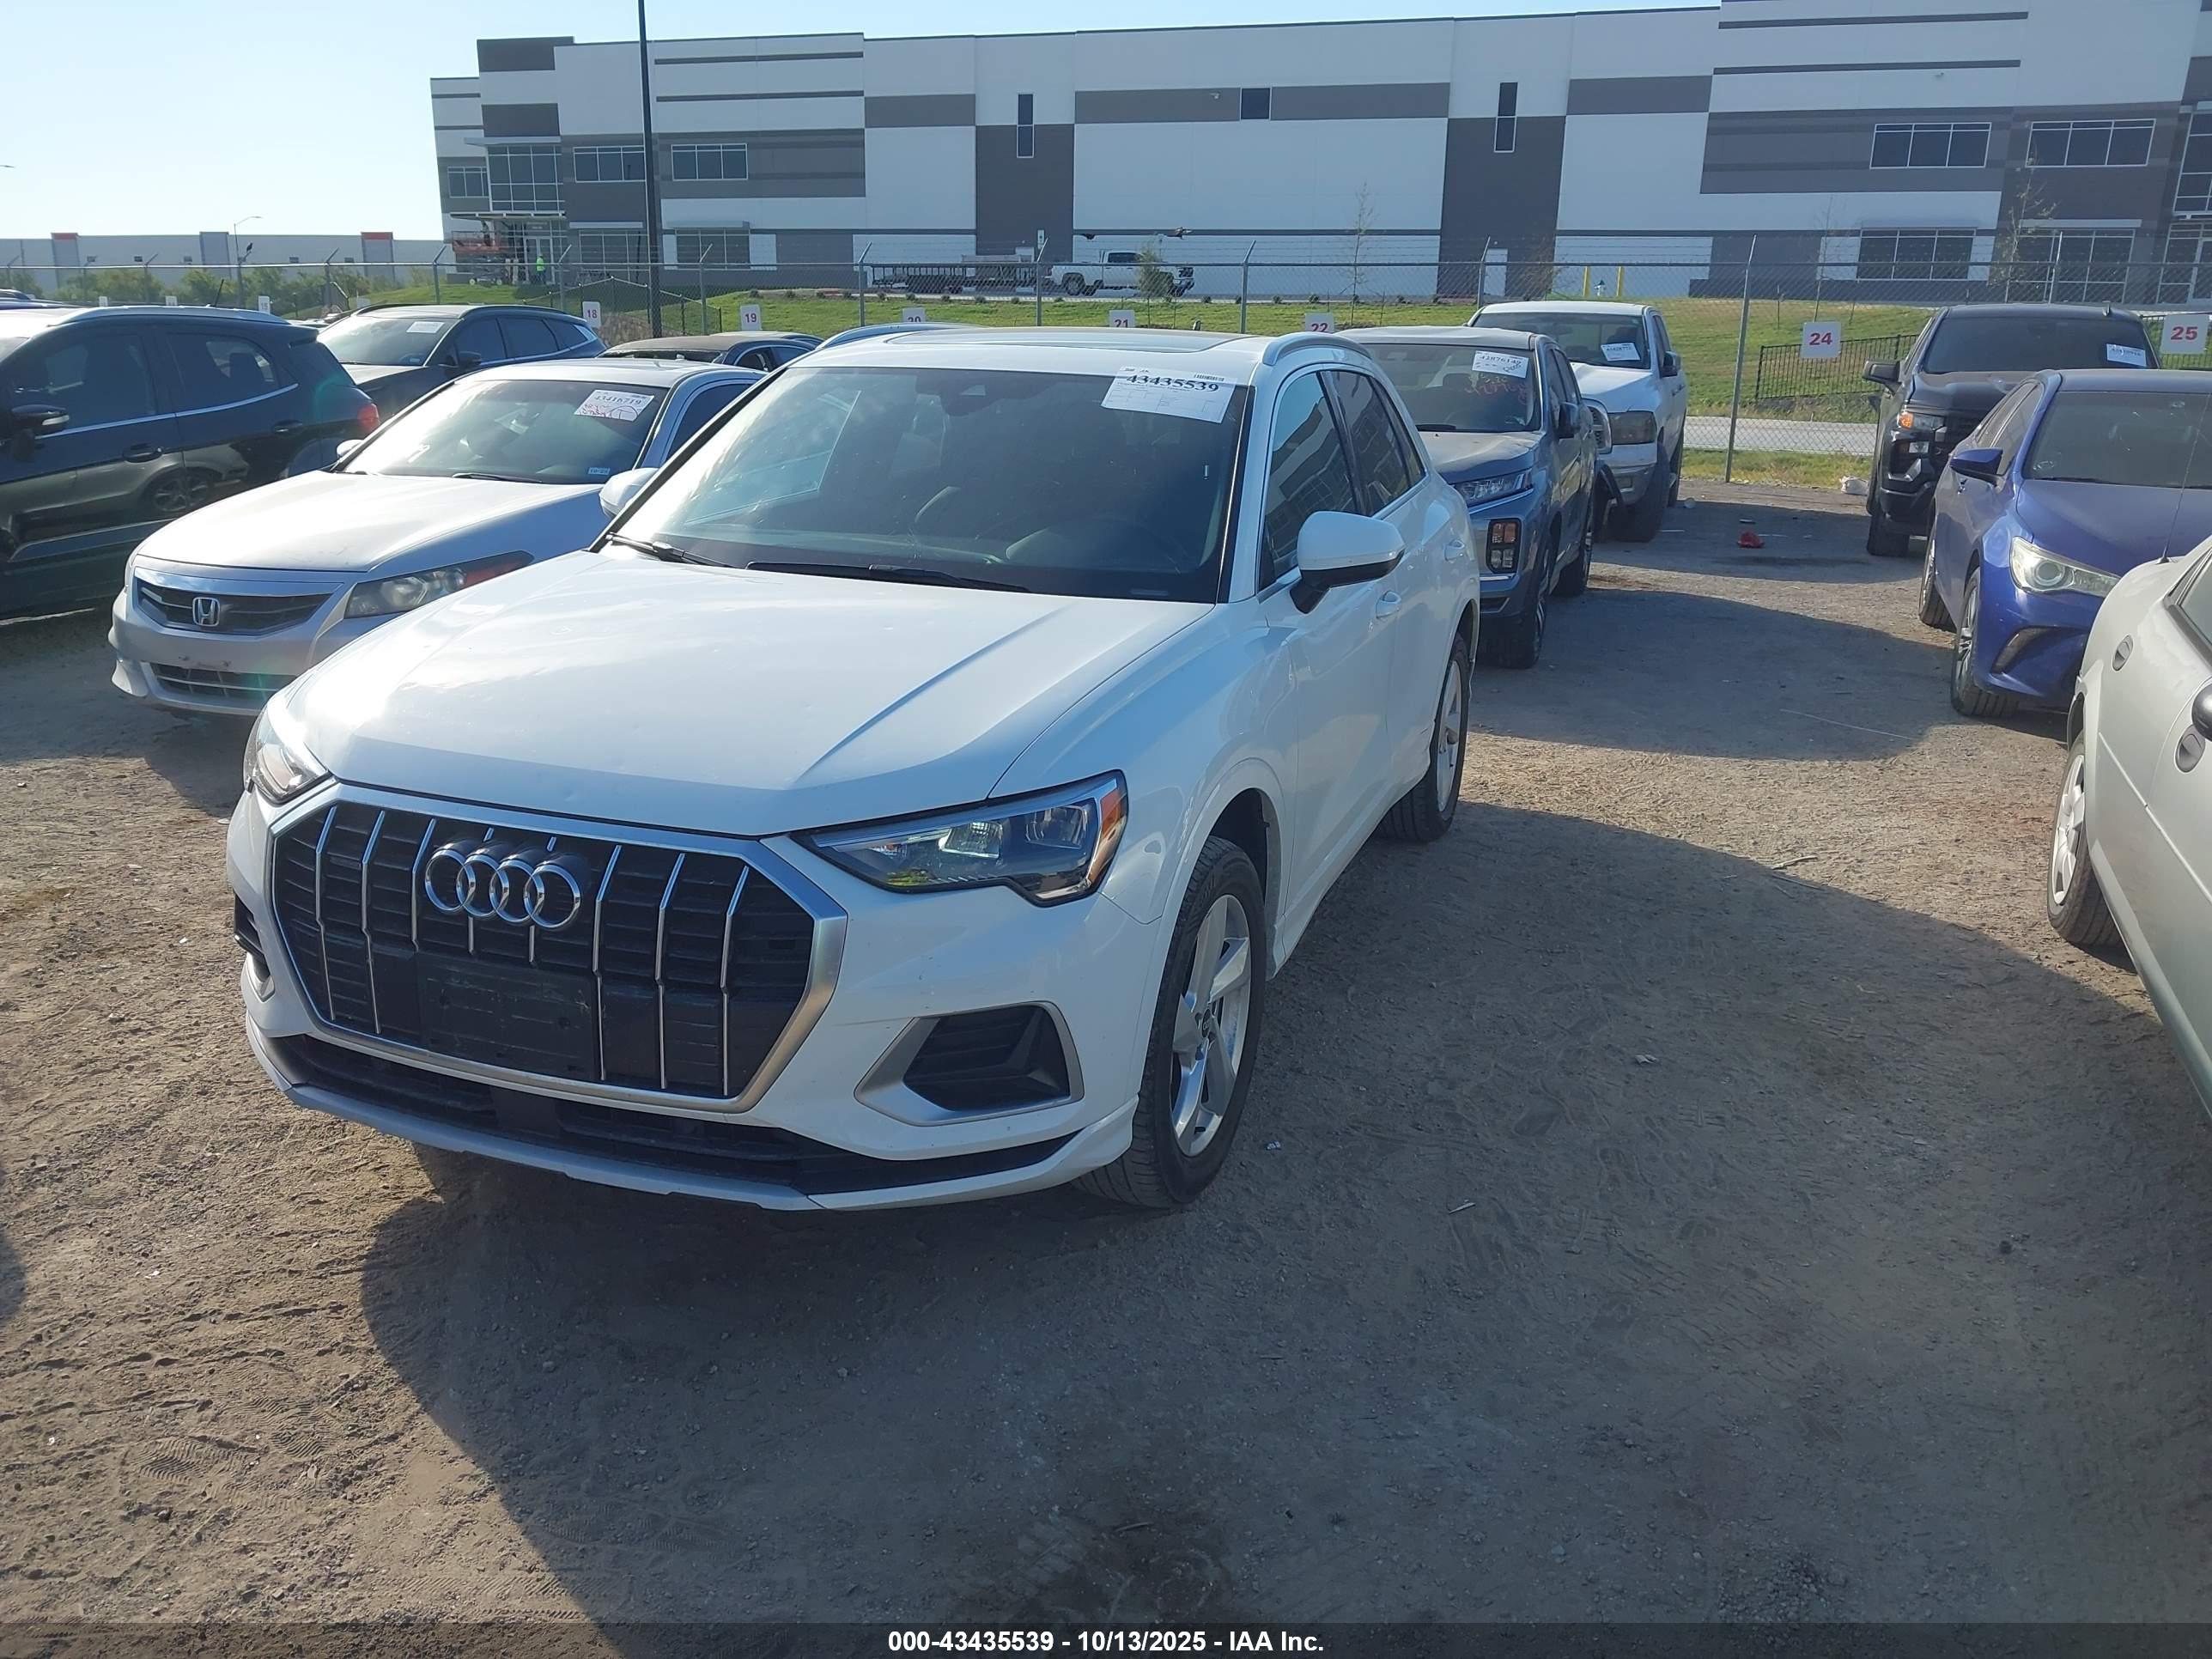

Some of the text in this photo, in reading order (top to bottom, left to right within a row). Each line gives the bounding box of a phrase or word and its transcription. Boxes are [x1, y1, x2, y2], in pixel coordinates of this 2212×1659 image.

[587, 309, 598, 318] 18
[745, 313, 757, 323] 19
[1115, 319, 1128, 328] 21
[1311, 323, 1328, 332] 22
[2171, 326, 2198, 340] 25
[1809, 332, 1833, 345] 24
[1126, 374, 1219, 392] 43435539
